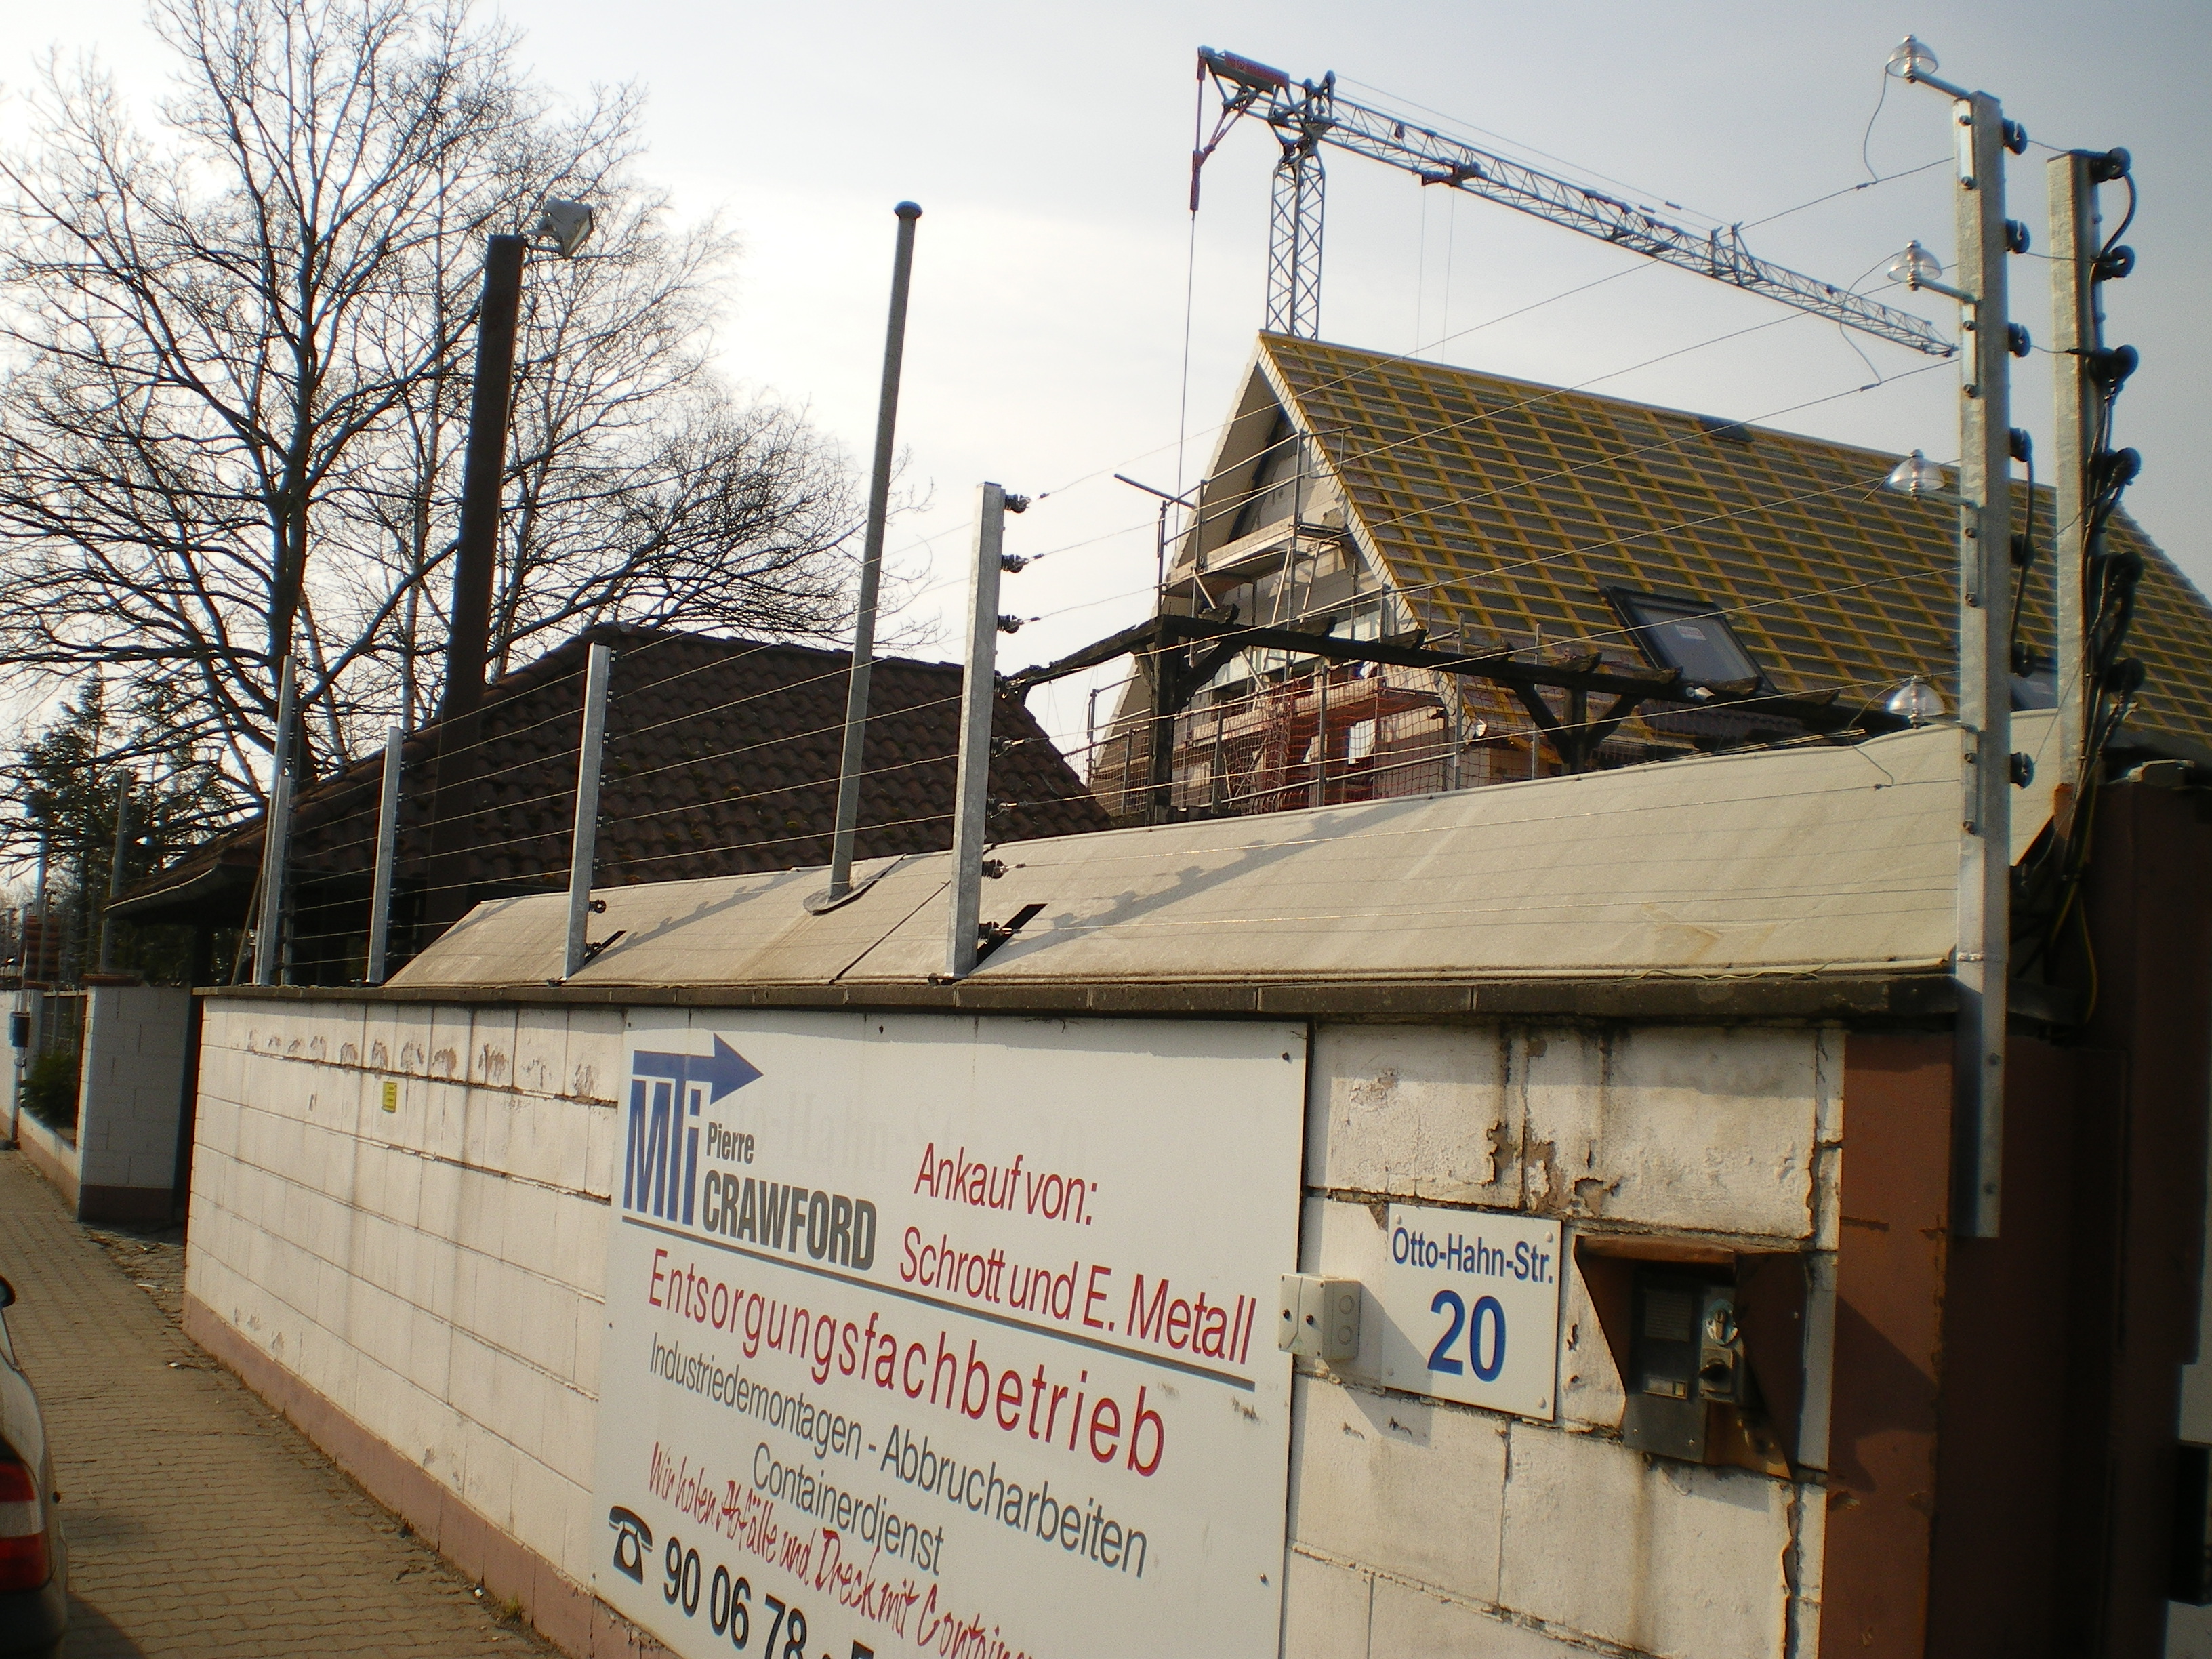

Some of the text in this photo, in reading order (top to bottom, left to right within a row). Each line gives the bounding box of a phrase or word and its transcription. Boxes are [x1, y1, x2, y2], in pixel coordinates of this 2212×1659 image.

[706, 1122, 754, 1164] Pierre
[914, 1142, 1098, 1225] Ankauf von:
[702, 1169, 877, 1271] CRAWFORD
[1393, 1227, 1553, 1284] Otto-Hahn-Str.
[900, 1226, 1257, 1365] Schrott und E. Metall
[1427, 1289, 1506, 1382] 20
[649, 1248, 1165, 1477] Entsorgungsfachbetrieb
[649, 1332, 862, 1460] Industriedemontagen
[880, 1424, 1148, 1578] Abbrucharbeiten
[753, 1441, 944, 1576] Containerdienst
[649, 1441, 676, 1500] Wir
[675, 1456, 716, 1525] holen
[716, 1480, 777, 1563] Abfälle
[779, 1528, 817, 1586] und
[815, 1527, 876, 1621] Dreck
[878, 1578, 920, 1639] mit
[663, 1536, 807, 1659] 90 06 78
